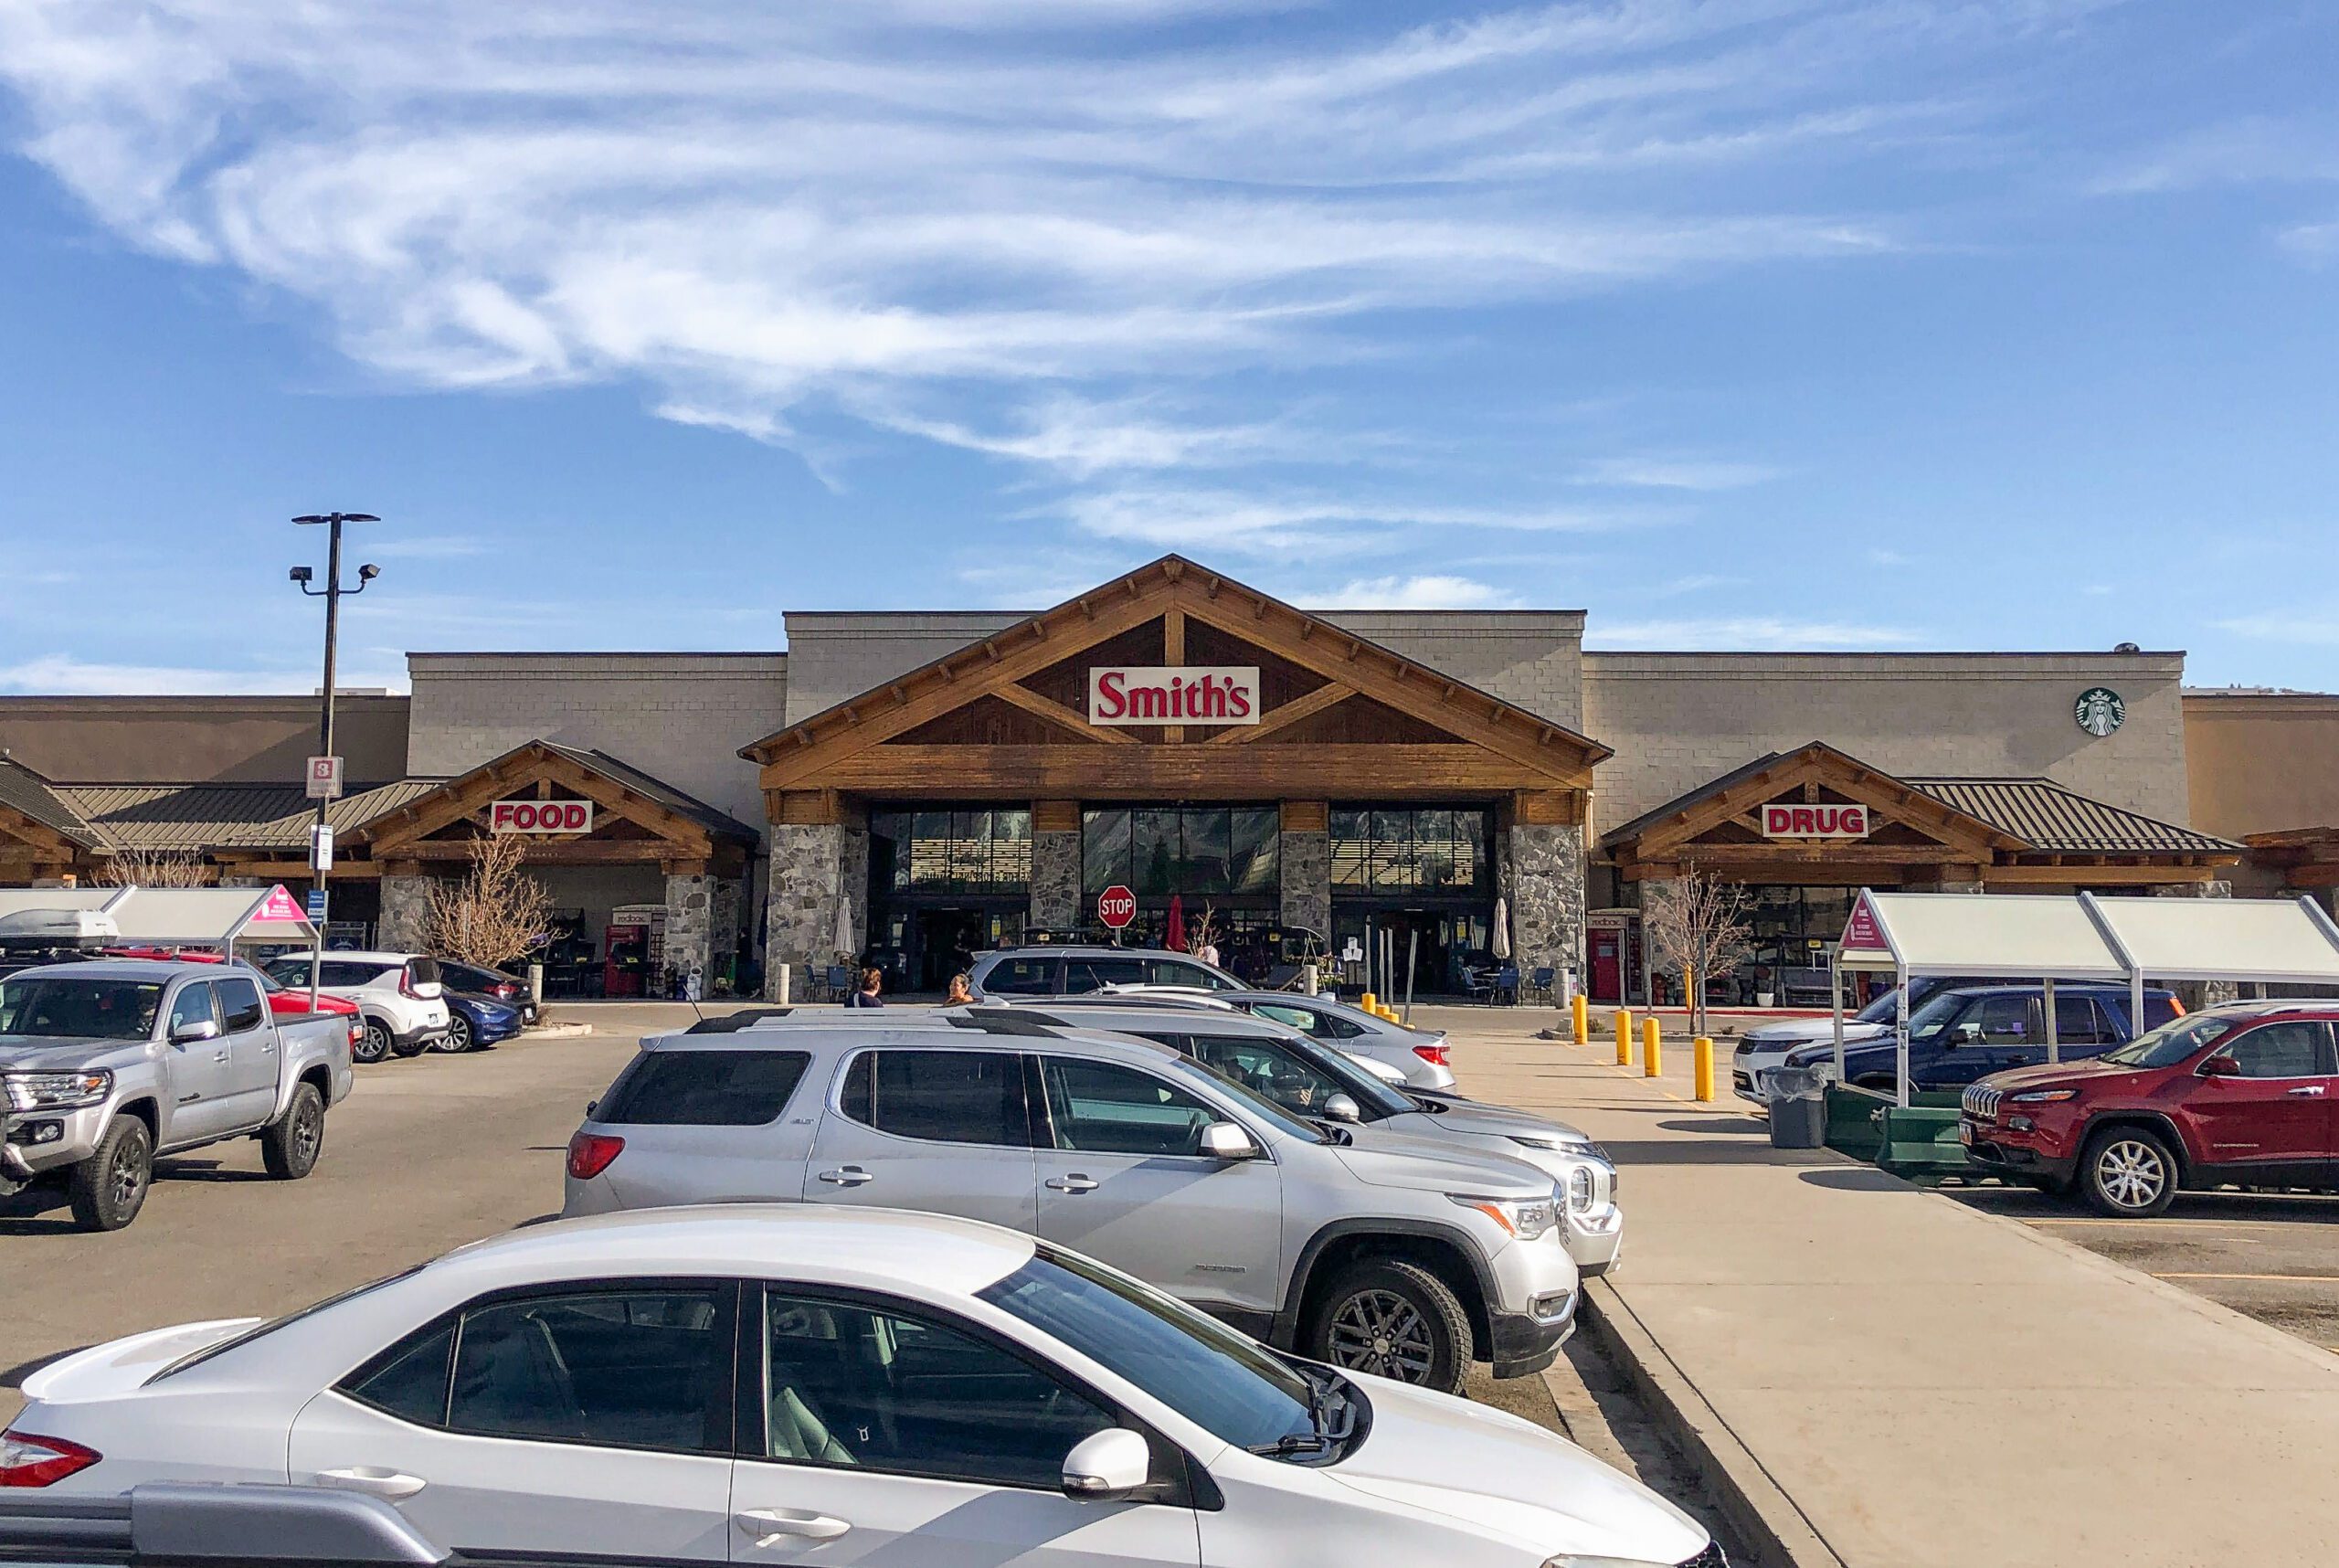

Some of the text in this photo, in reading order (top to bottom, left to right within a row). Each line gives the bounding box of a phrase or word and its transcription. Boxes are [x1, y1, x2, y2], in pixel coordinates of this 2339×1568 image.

[1097, 672, 1251, 718] Smith's
[317, 763, 329, 777] 3
[494, 804, 587, 830] FOOD
[1768, 808, 1864, 833] DRUG
[1101, 898, 1133, 915] STOP
